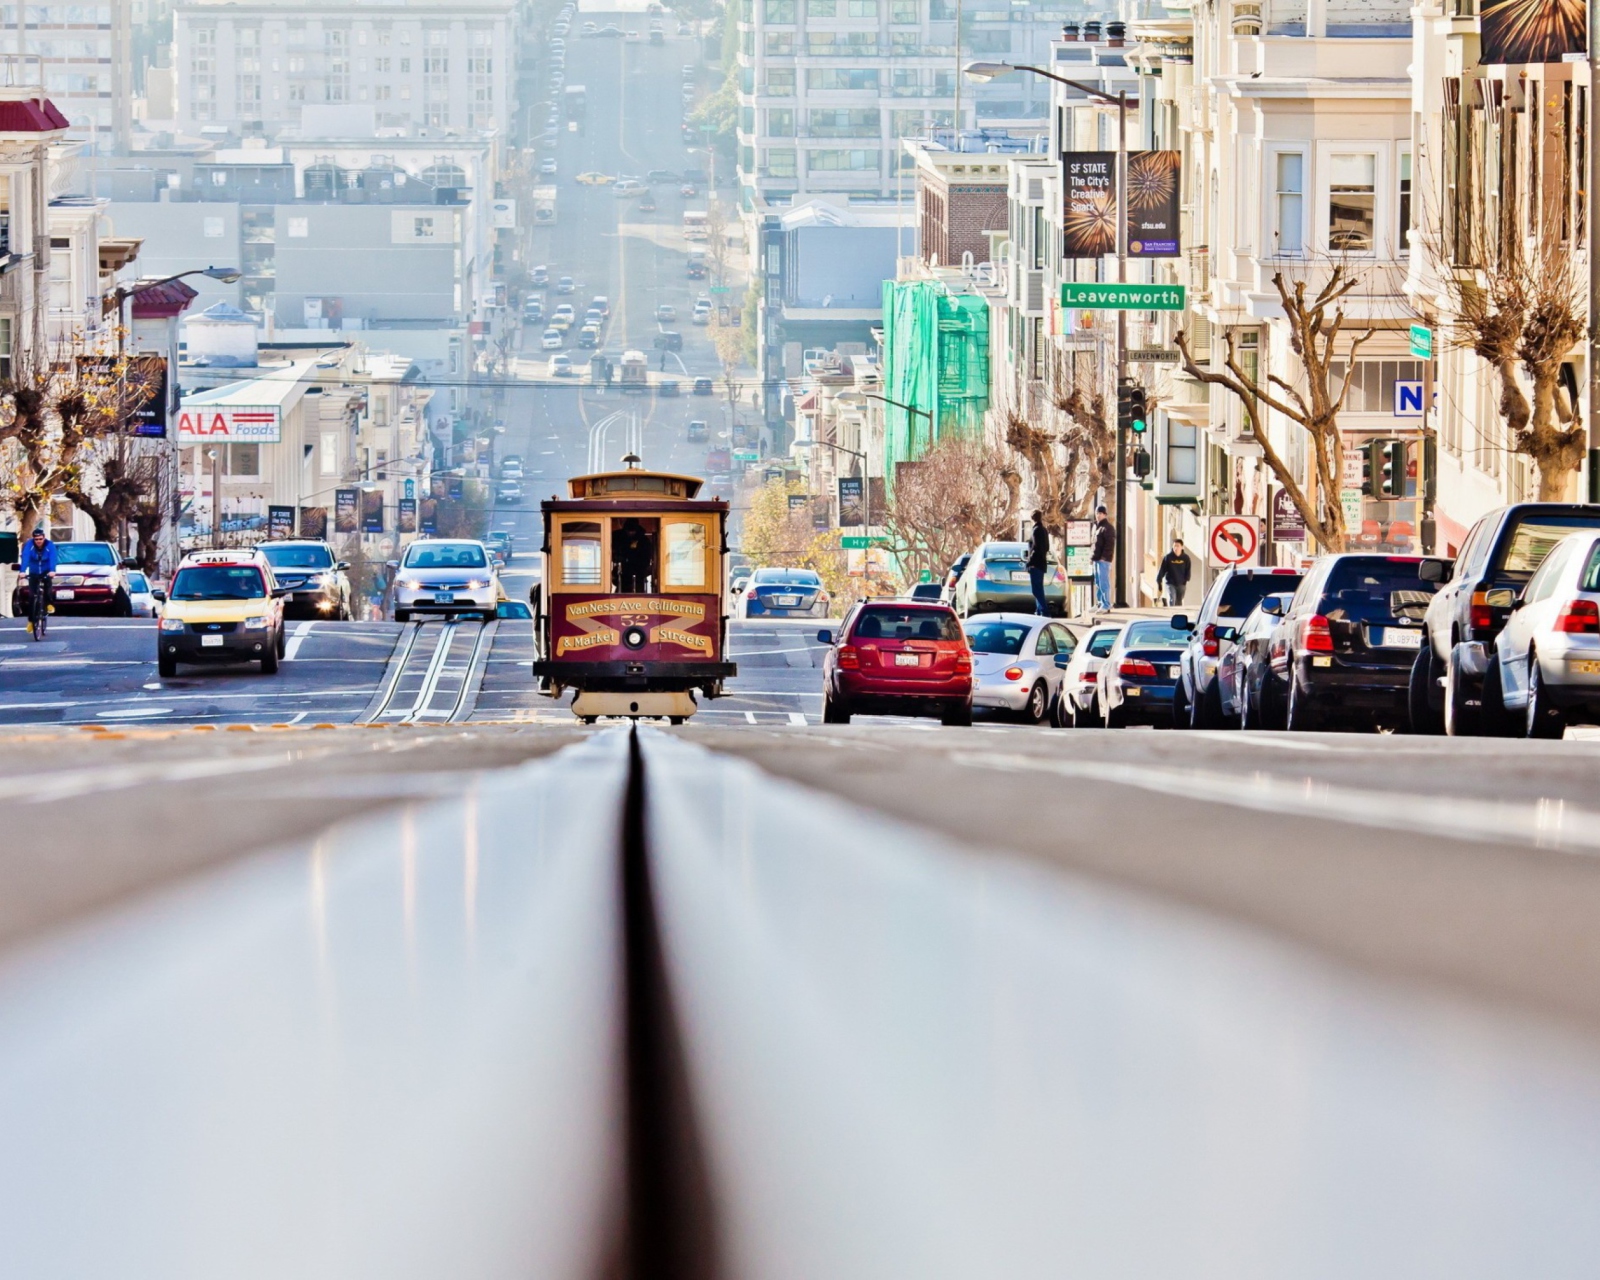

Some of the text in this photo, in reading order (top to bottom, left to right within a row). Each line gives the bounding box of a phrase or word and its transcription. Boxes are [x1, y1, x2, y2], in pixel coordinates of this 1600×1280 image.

[1070, 163, 1107, 174] SF STATE
[1070, 176, 1110, 187] The City's
[1070, 189, 1106, 199] Creative
[1070, 202, 1095, 213] Spark
[1141, 221, 1166, 230] sfsu.edu
[1066, 289, 1180, 304] Leavenworth
[235, 423, 275, 435] Foods
[569, 606, 588, 616] Van
[589, 602, 616, 613] Ness
[648, 600, 703, 615] California
[620, 614, 649, 627] 52
[563, 631, 615, 648] & Market
[659, 629, 705, 647] Streets
